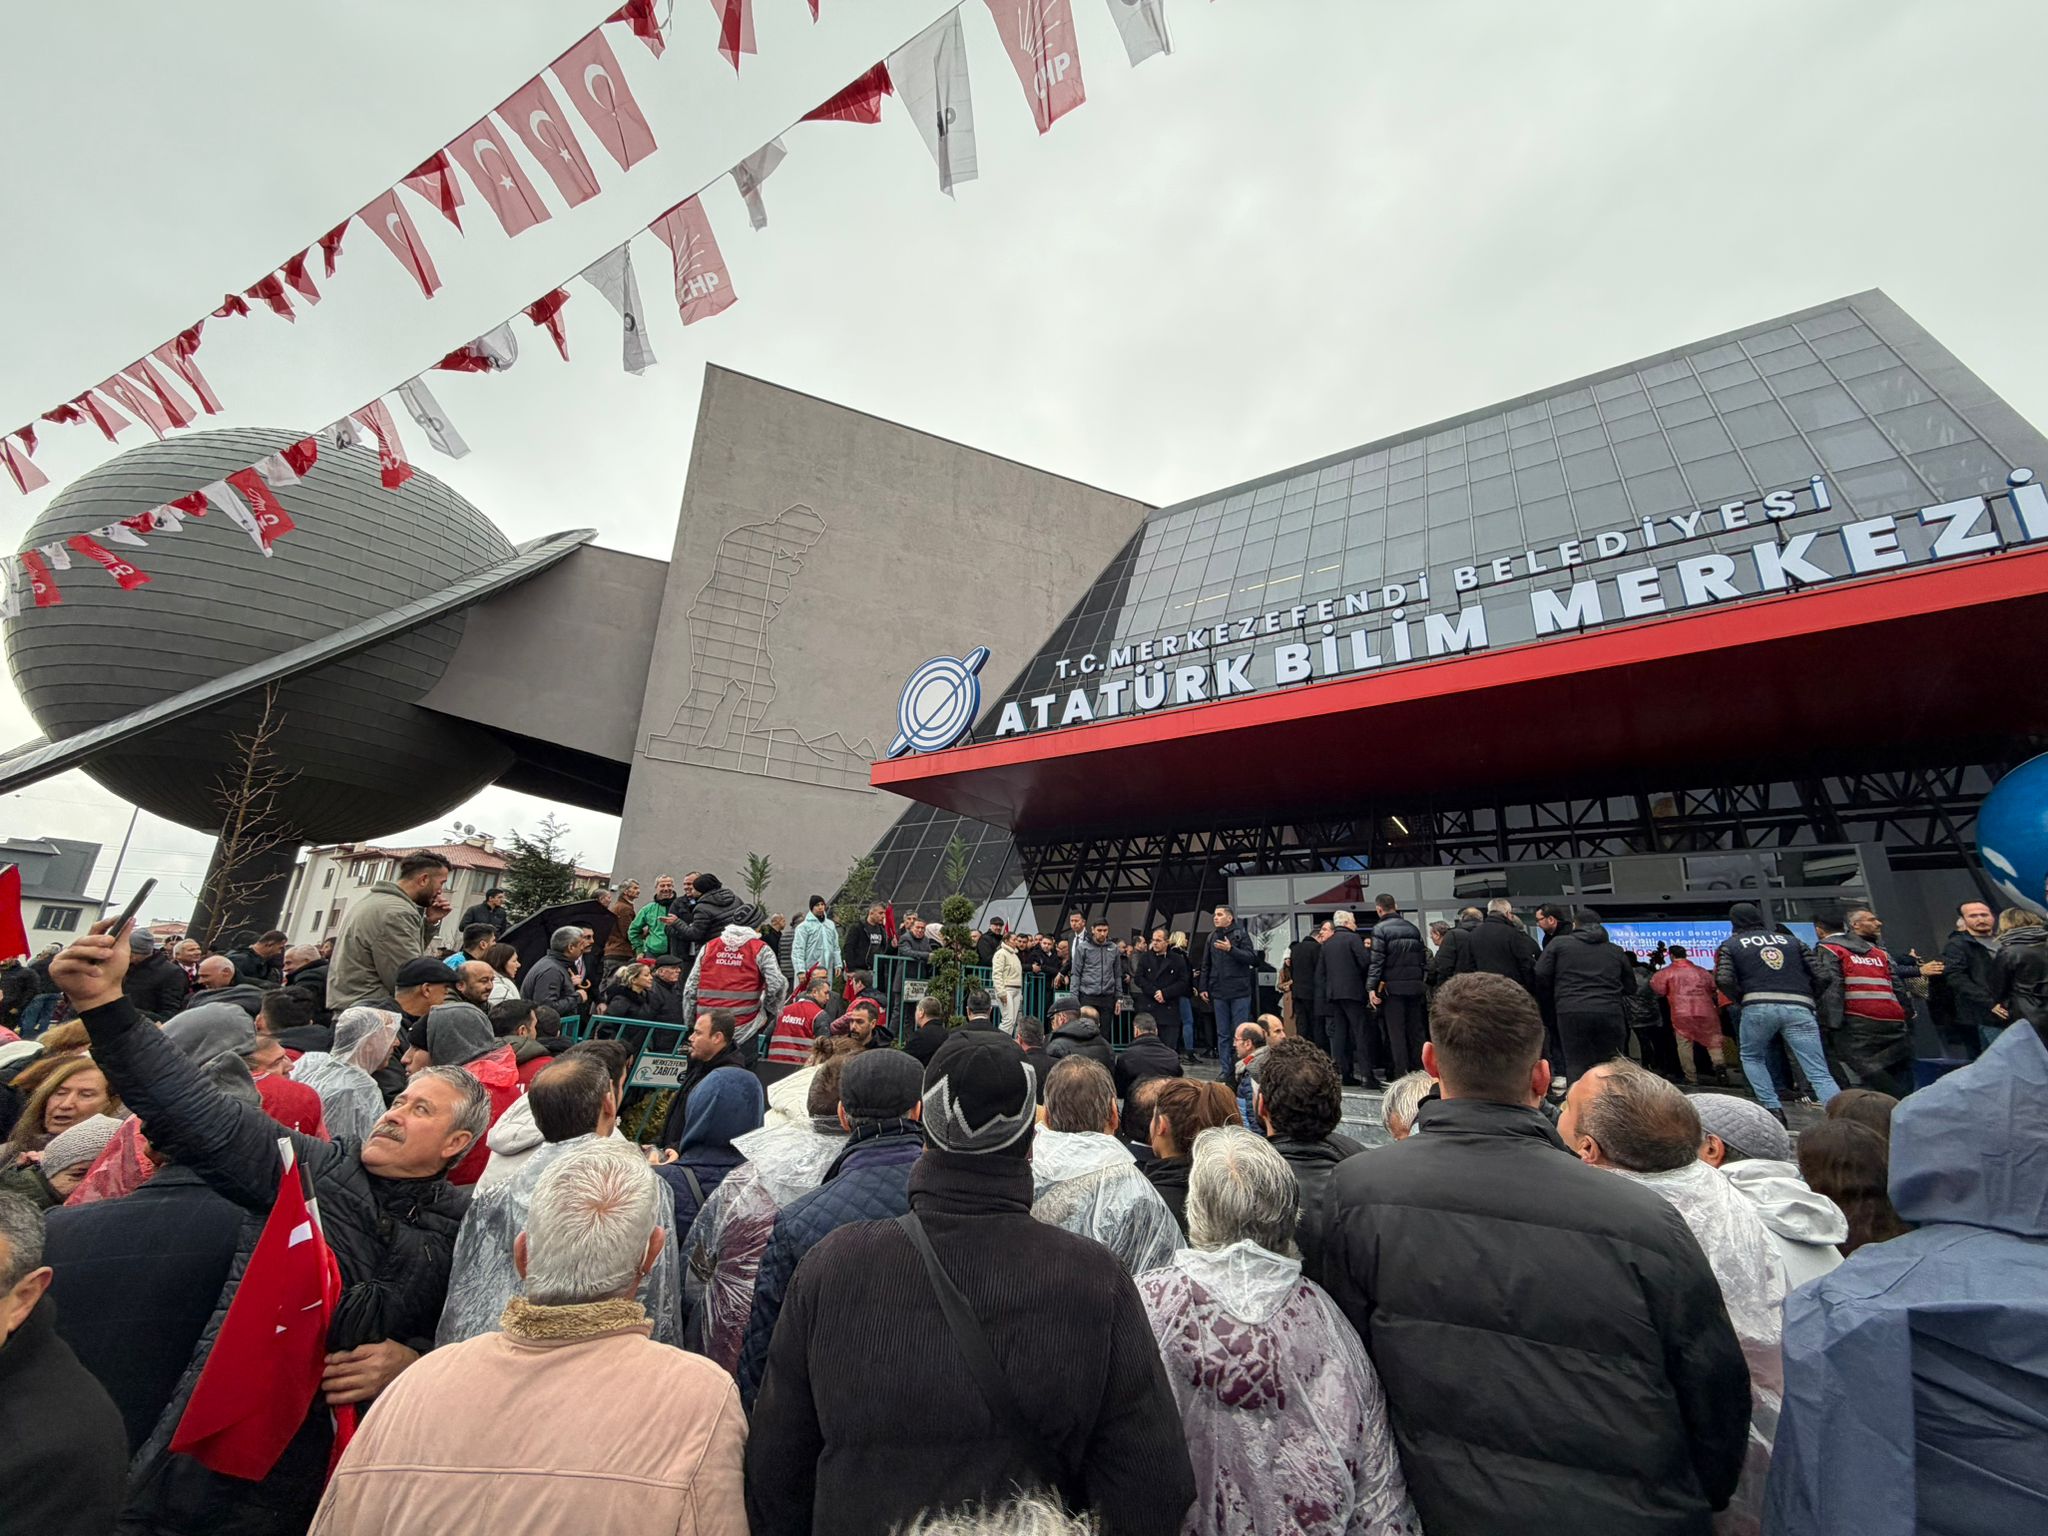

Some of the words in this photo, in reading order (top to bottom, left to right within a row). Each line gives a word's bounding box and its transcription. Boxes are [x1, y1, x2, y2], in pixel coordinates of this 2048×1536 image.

[995, 653, 1257, 737] ATATÜRK
[1274, 607, 1489, 686] BİLİM
[1530, 467, 2048, 637] MERKEZİ
[1110, 571, 1429, 669] MERKEZEFENDİ
[1453, 474, 1832, 592] BELEDİYESİ
